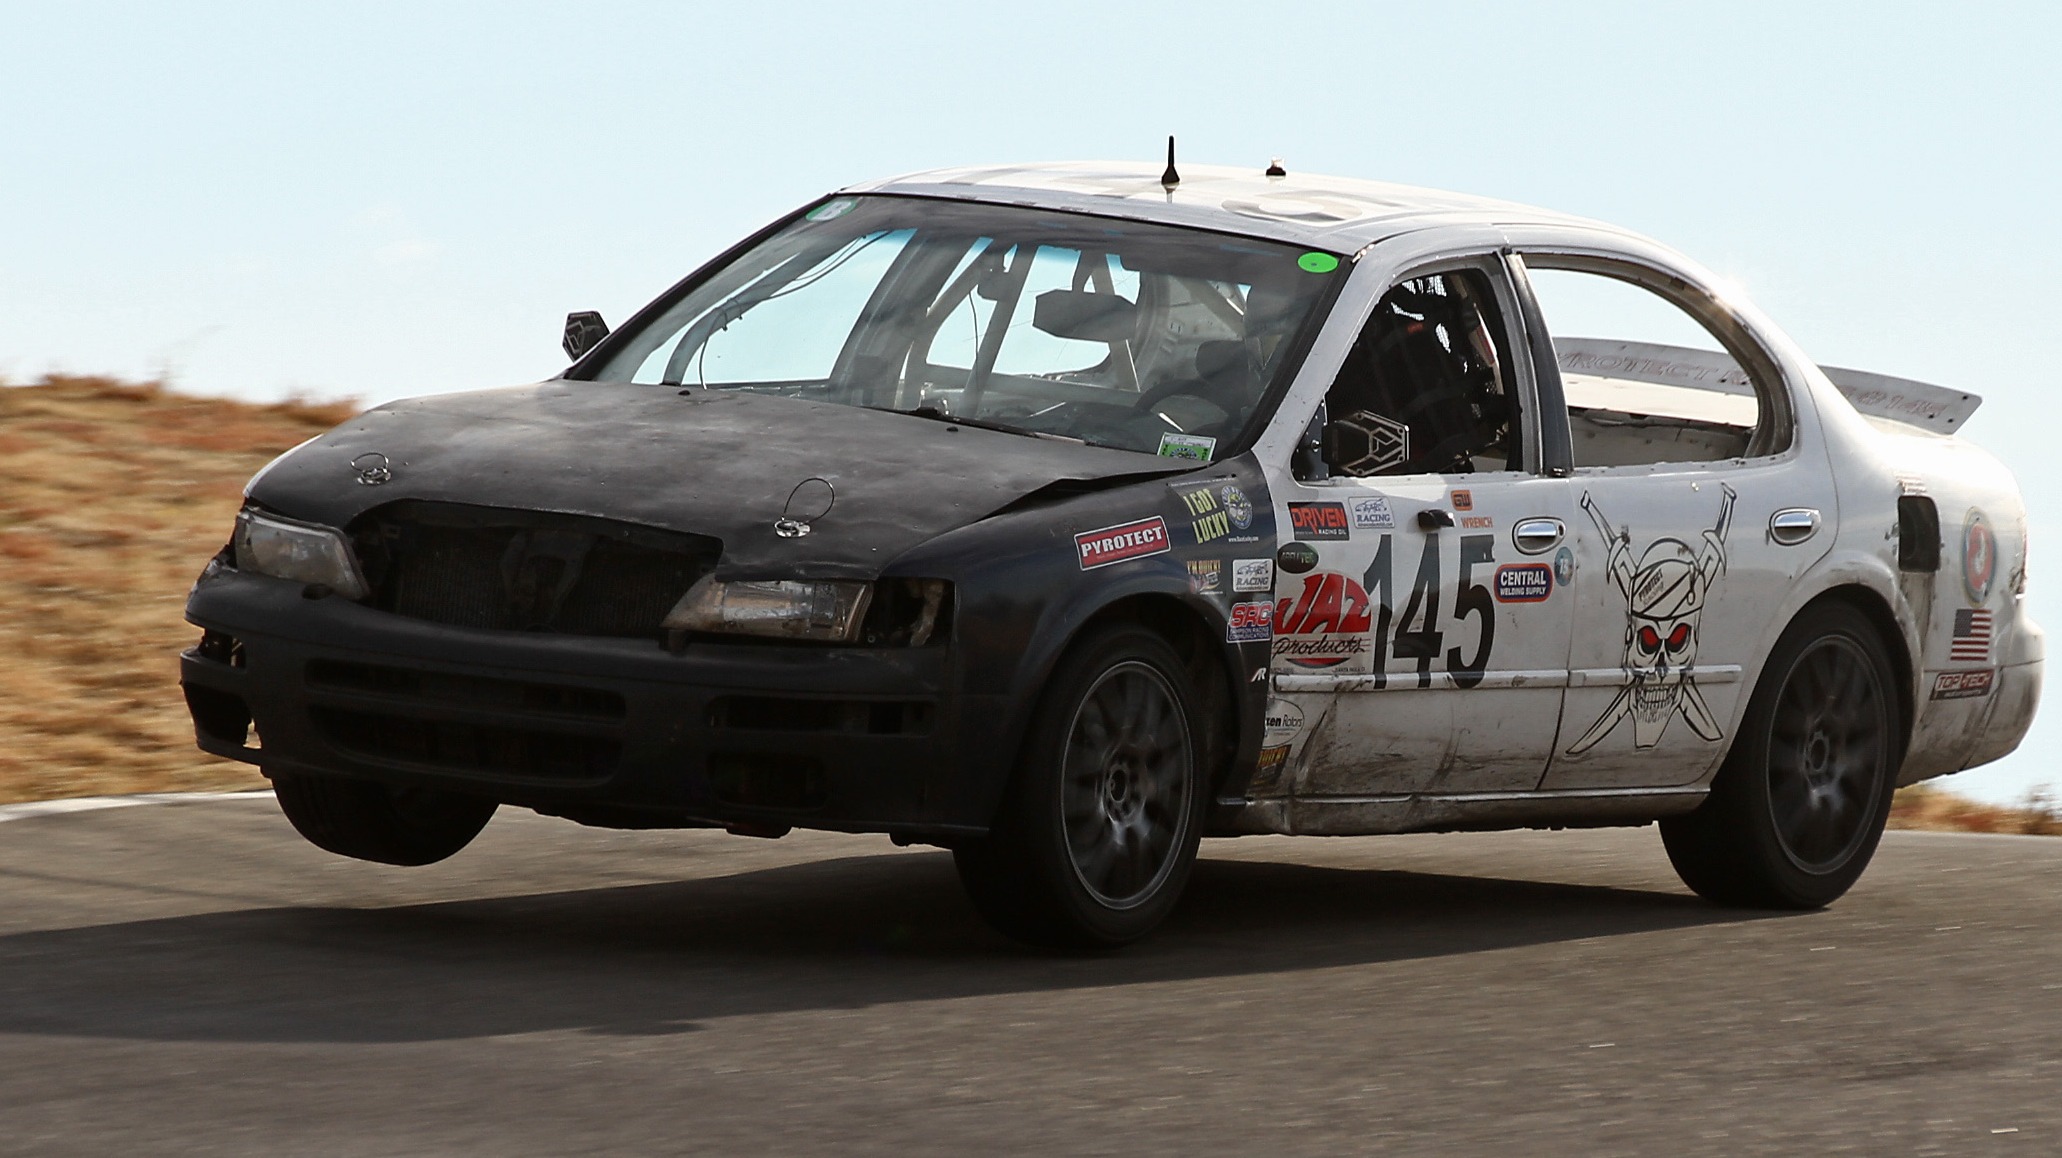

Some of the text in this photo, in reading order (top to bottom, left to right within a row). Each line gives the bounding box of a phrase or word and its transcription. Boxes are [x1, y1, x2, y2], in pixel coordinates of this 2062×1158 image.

[1190, 488, 1218, 514] GOT
[1192, 510, 1230, 545] LUCKY
[1290, 508, 1347, 535] DRIVEN
[1357, 514, 1391, 522] RACING
[1461, 517, 1493, 529] WRENCH
[1081, 526, 1162, 557] PYROTECT
[1236, 577, 1269, 586] RACING
[1500, 570, 1546, 586] CENTRAL
[1500, 587, 1546, 596] WELDING SUPPLY
[1231, 604, 1272, 627] SRC
[1274, 573, 1372, 635] JAZ
[1363, 533, 1495, 689] 145
